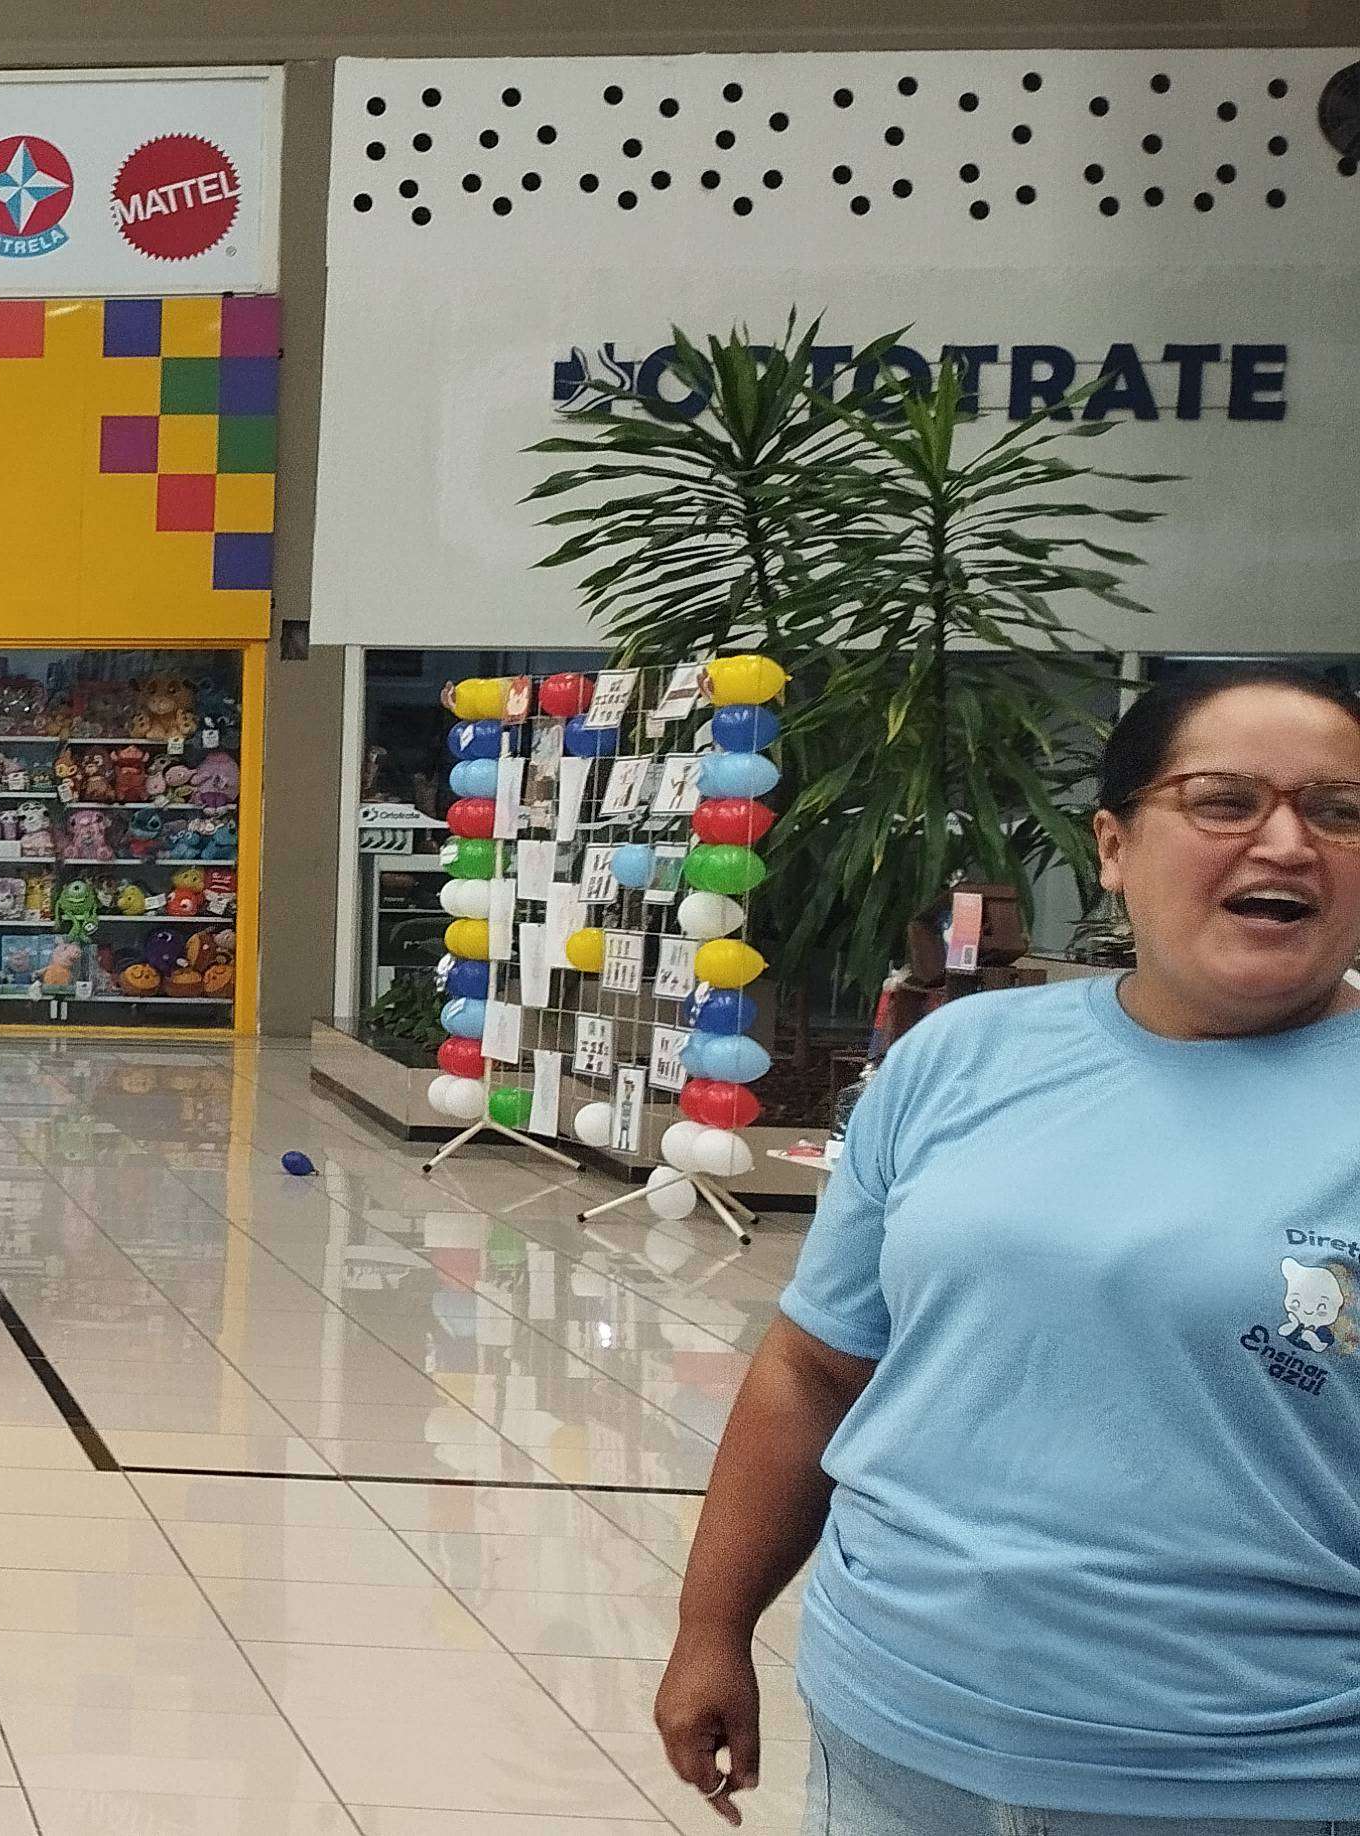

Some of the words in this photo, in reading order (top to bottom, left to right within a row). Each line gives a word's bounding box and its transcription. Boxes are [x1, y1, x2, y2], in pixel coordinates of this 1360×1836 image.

[114, 170, 242, 226] MATTEL
[1285, 1228, 1360, 1262] Diret
[1240, 1324, 1329, 1380] Ensinar
[1268, 1362, 1328, 1397] azul
